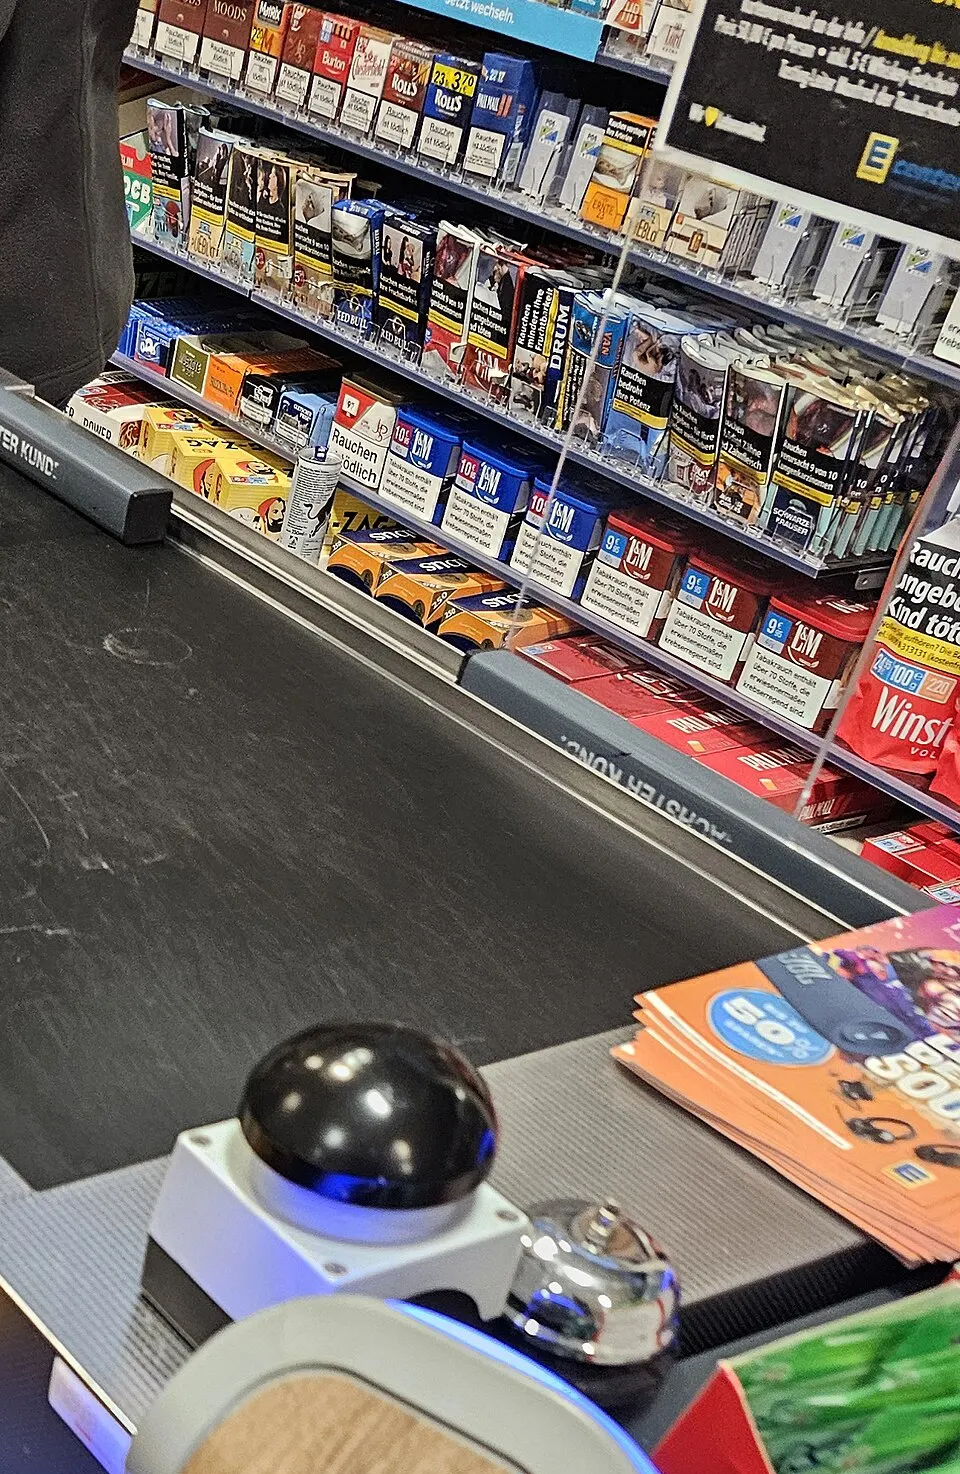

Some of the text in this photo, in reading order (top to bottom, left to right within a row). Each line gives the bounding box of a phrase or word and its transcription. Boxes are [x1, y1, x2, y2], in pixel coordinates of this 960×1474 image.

[213, 0, 248, 22] MOODS
[469, 1, 516, 25] wechseln.
[322, 51, 346, 71] Burton
[518, 304, 532, 345] Rauchen
[527, 310, 541, 349] mindert
[535, 287, 554, 352] Fruchtbarkeit
[549, 304, 571, 371] DRUM
[618, 378, 644, 398] bedroht
[619, 366, 648, 387] Rauchen
[629, 393, 652, 414] Potenz
[331, 428, 379, 464] Rauchen
[411, 427, 434, 461] L&M
[783, 439, 808, 458] Rauchen
[20, 440, 60, 480] KUND
[779, 451, 811, 471] verursacht
[814, 466, 828, 478] von
[828, 471, 839, 482] 10
[477, 461, 502, 497] L&M
[777, 460, 835, 492] Lungenkarzinomen
[549, 498, 576, 534] L&M
[625, 535, 654, 572] L&M
[431, 591, 449, 610] 250
[593, 576, 644, 608] über 70 Stoffe, die
[628, 583, 650, 600] enthält
[709, 576, 738, 613] L&M
[443, 607, 457, 619] 250
[625, 616, 640, 628] sind.
[766, 618, 777, 635] 9
[925, 613, 960, 643] töt
[673, 617, 728, 651] über 70 Stoffe, die
[711, 625, 733, 642] enthält
[790, 620, 824, 659] L&M
[707, 658, 723, 671] sind.
[754, 651, 818, 689] Tabakrauch enthält
[890, 664, 915, 688] 100
[749, 673, 807, 707] erwiesenermaßen
[752, 663, 811, 698] über 70 Stoffe, die
[742, 681, 806, 719] krebserregend sind.
[666, 716, 710, 734] PALL
[737, 753, 781, 772] PALL
